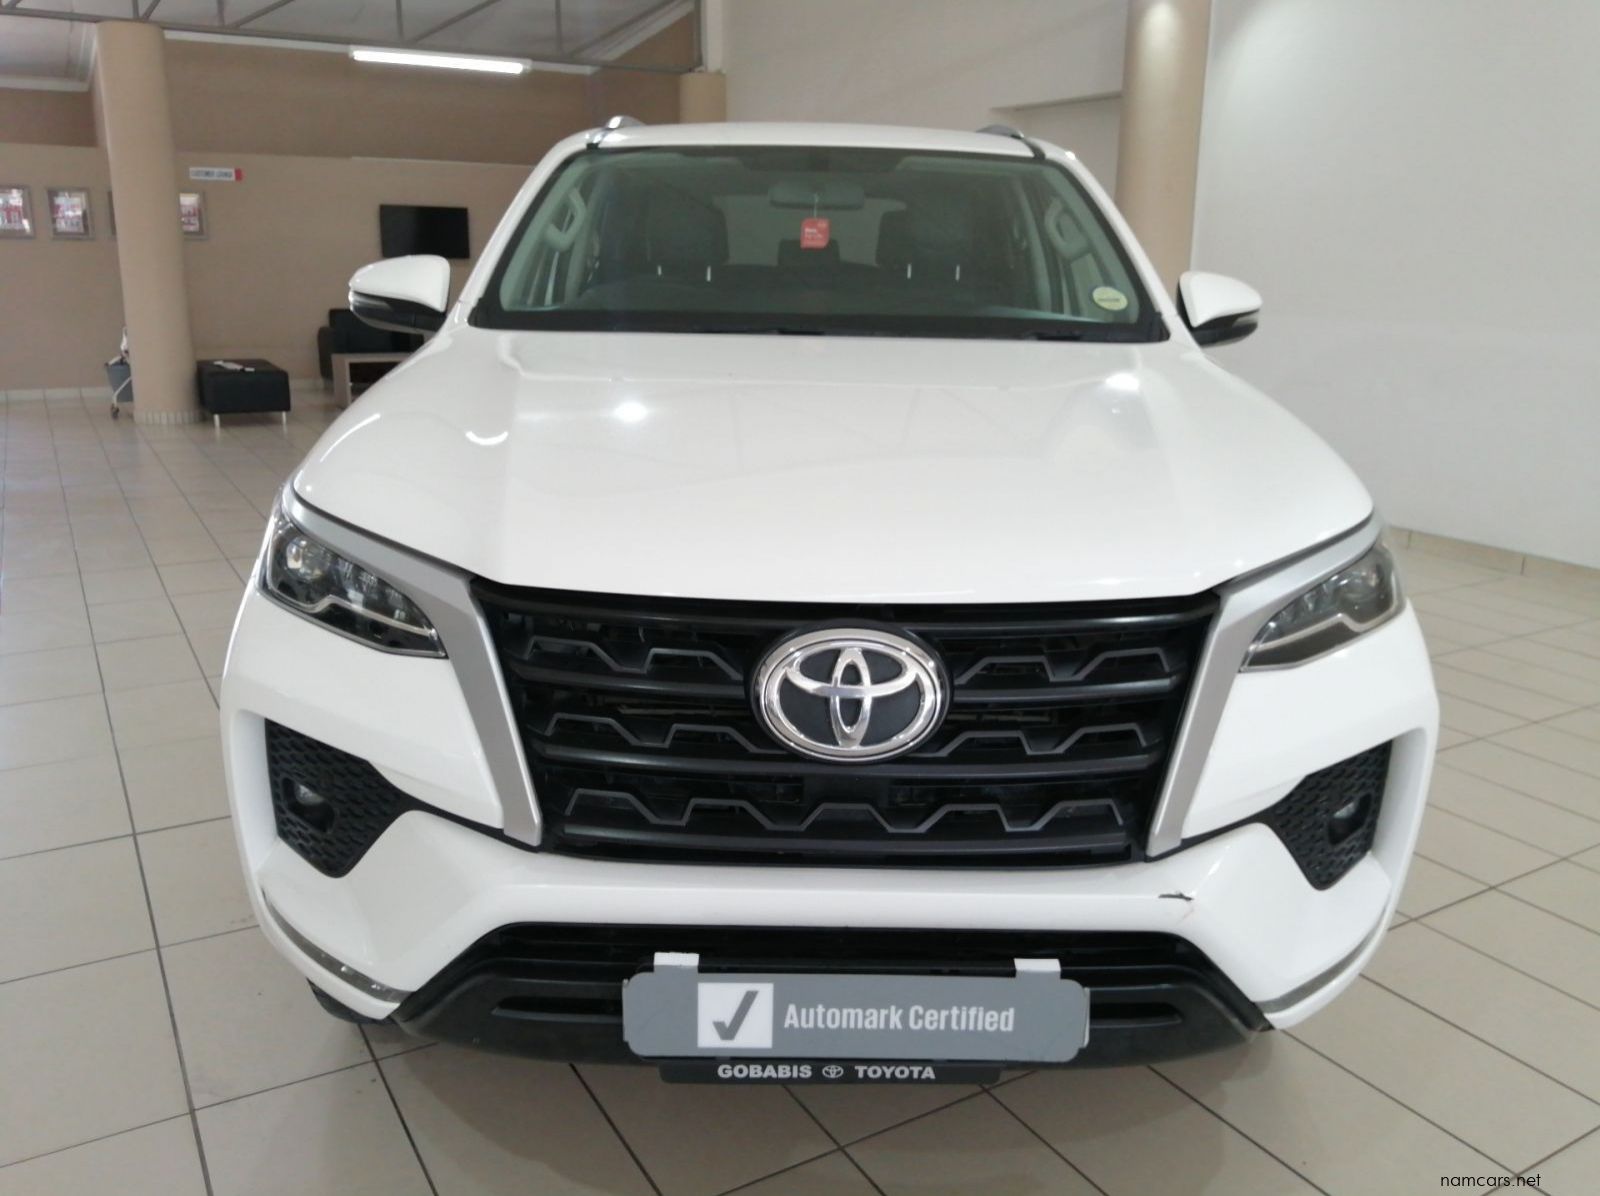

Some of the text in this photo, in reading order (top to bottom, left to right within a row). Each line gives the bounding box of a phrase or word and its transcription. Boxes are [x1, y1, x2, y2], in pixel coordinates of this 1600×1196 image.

[784, 1003, 1015, 1032] Automark Certified
[717, 1064, 936, 1080] GOBABIS TOYOTA
